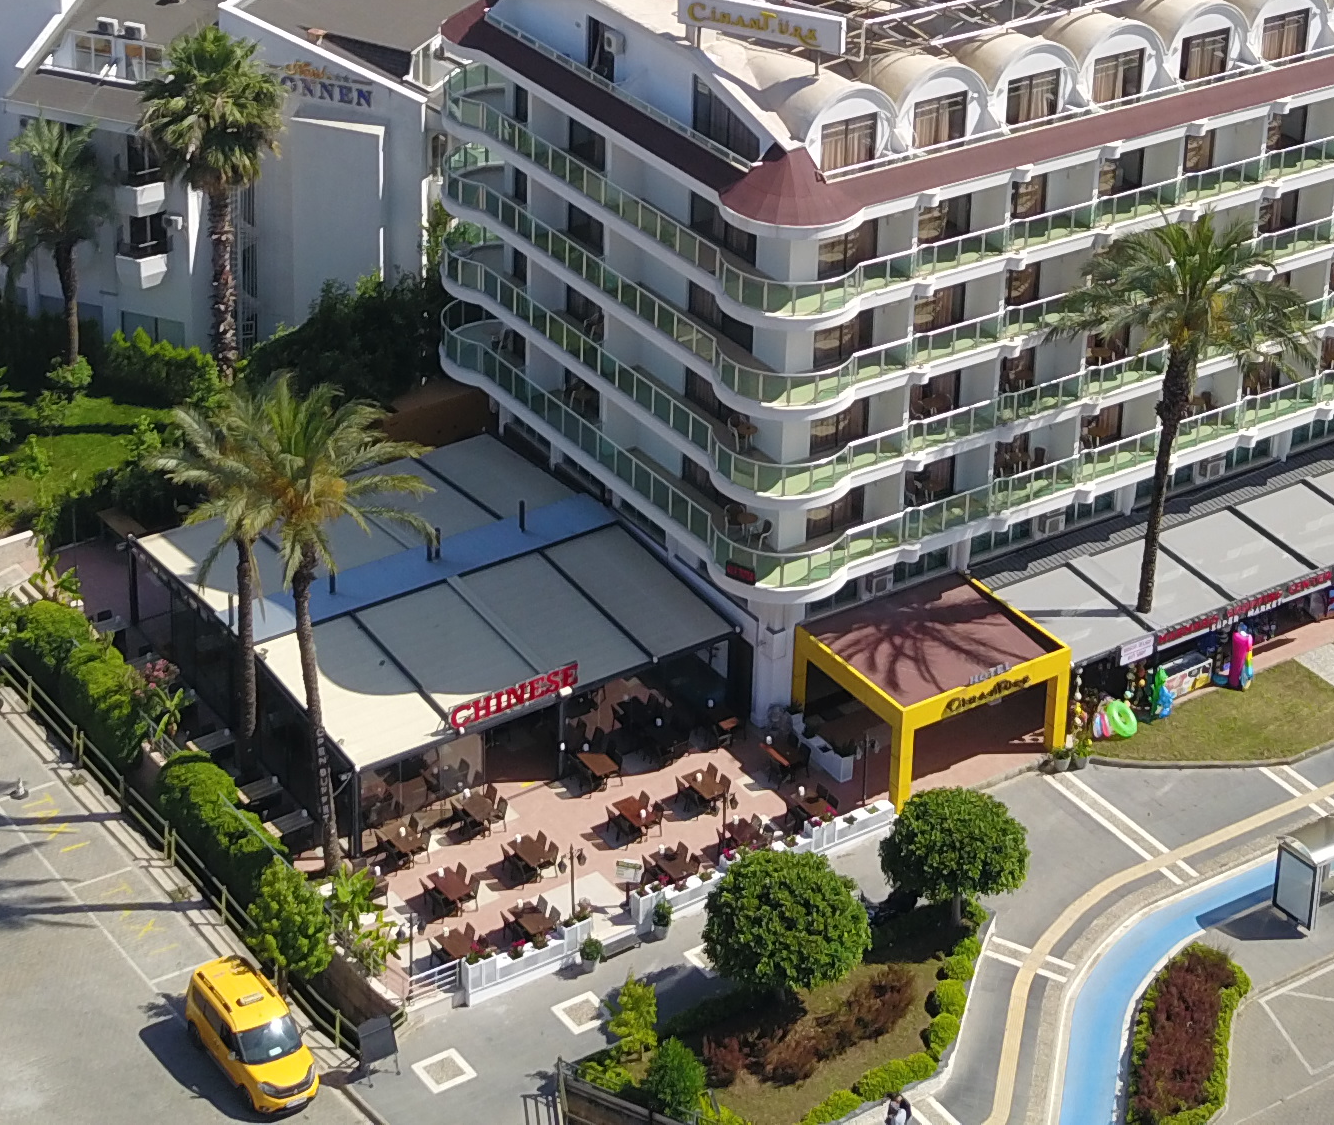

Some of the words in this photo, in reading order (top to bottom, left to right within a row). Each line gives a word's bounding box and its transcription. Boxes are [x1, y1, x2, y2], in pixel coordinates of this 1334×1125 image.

[280, 76, 373, 108] ONNEN
[1227, 589, 1283, 617] SHOPPING
[1288, 571, 1332, 595] CENTER
[1247, 597, 1283, 617] MARKET
[970, 661, 1011, 684] HOTEL
[450, 662, 579, 729] CHINESE
